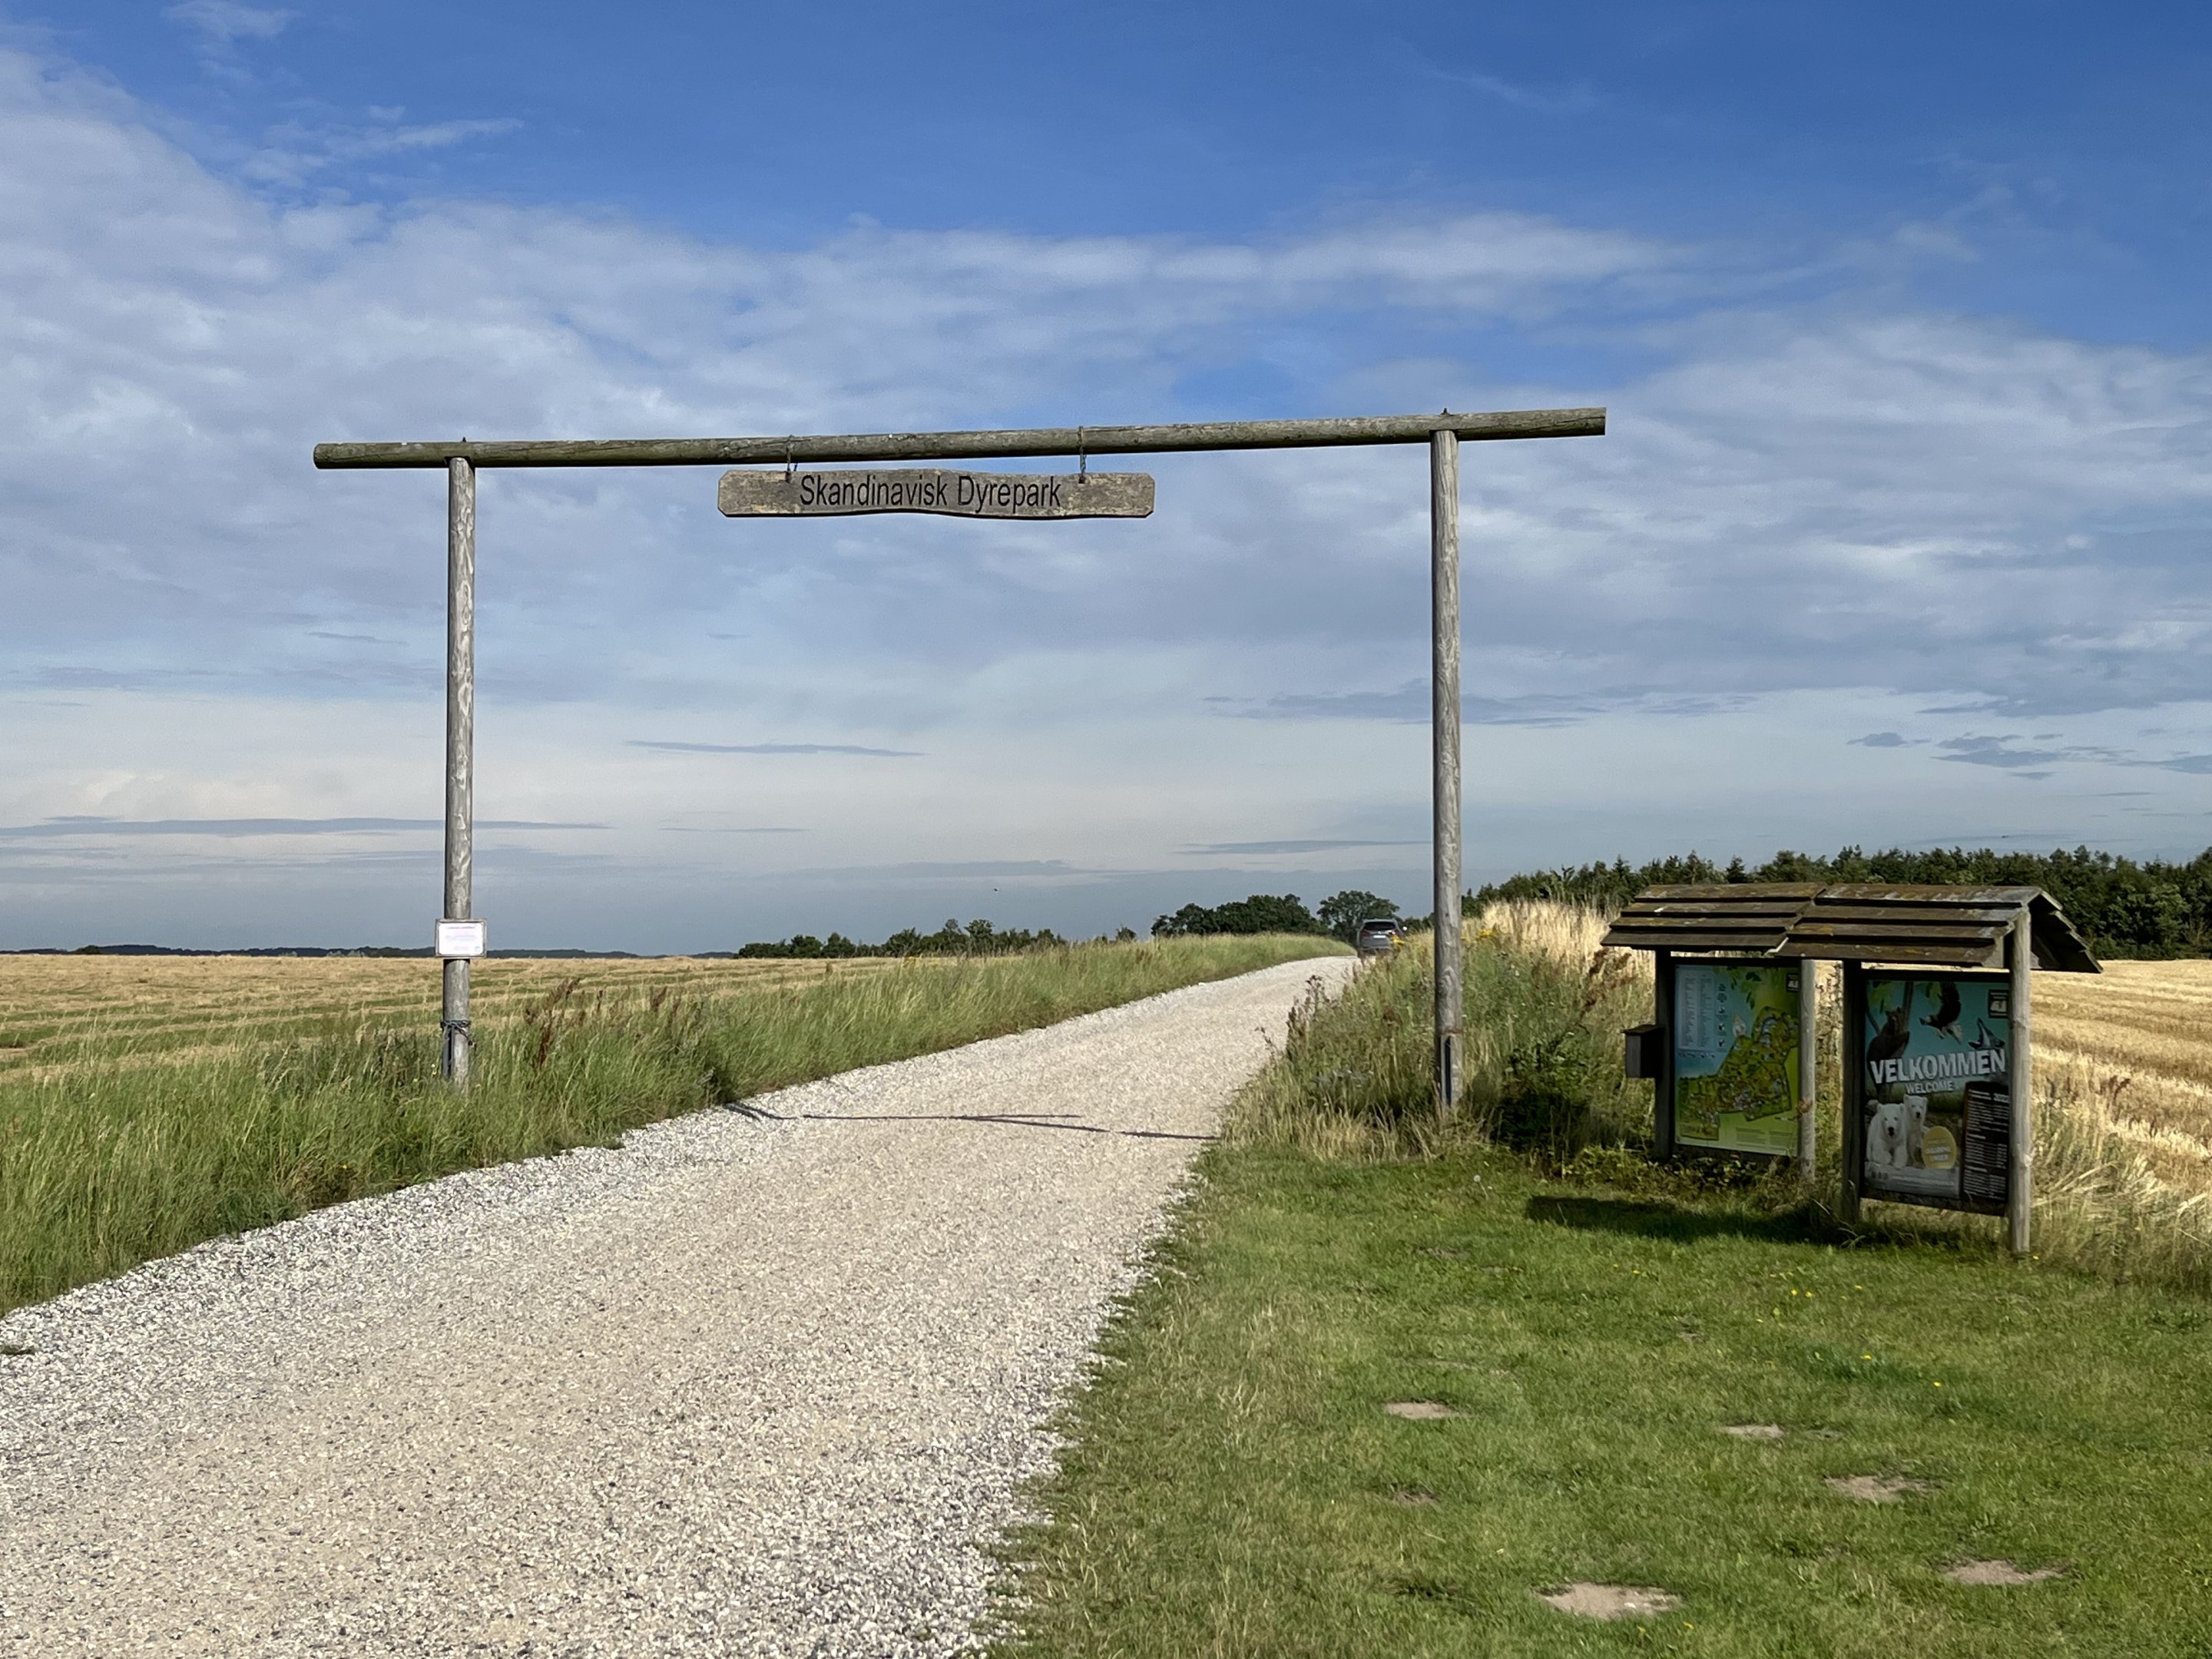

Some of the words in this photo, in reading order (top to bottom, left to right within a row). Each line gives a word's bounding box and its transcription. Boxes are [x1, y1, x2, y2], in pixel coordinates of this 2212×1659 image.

[800, 474, 948, 506] Skandinavisk
[957, 475, 1061, 514] Dyrepark
[1869, 1048, 2006, 1084] VELKOMMEN
[1906, 1081, 1955, 1094] WELCOME
